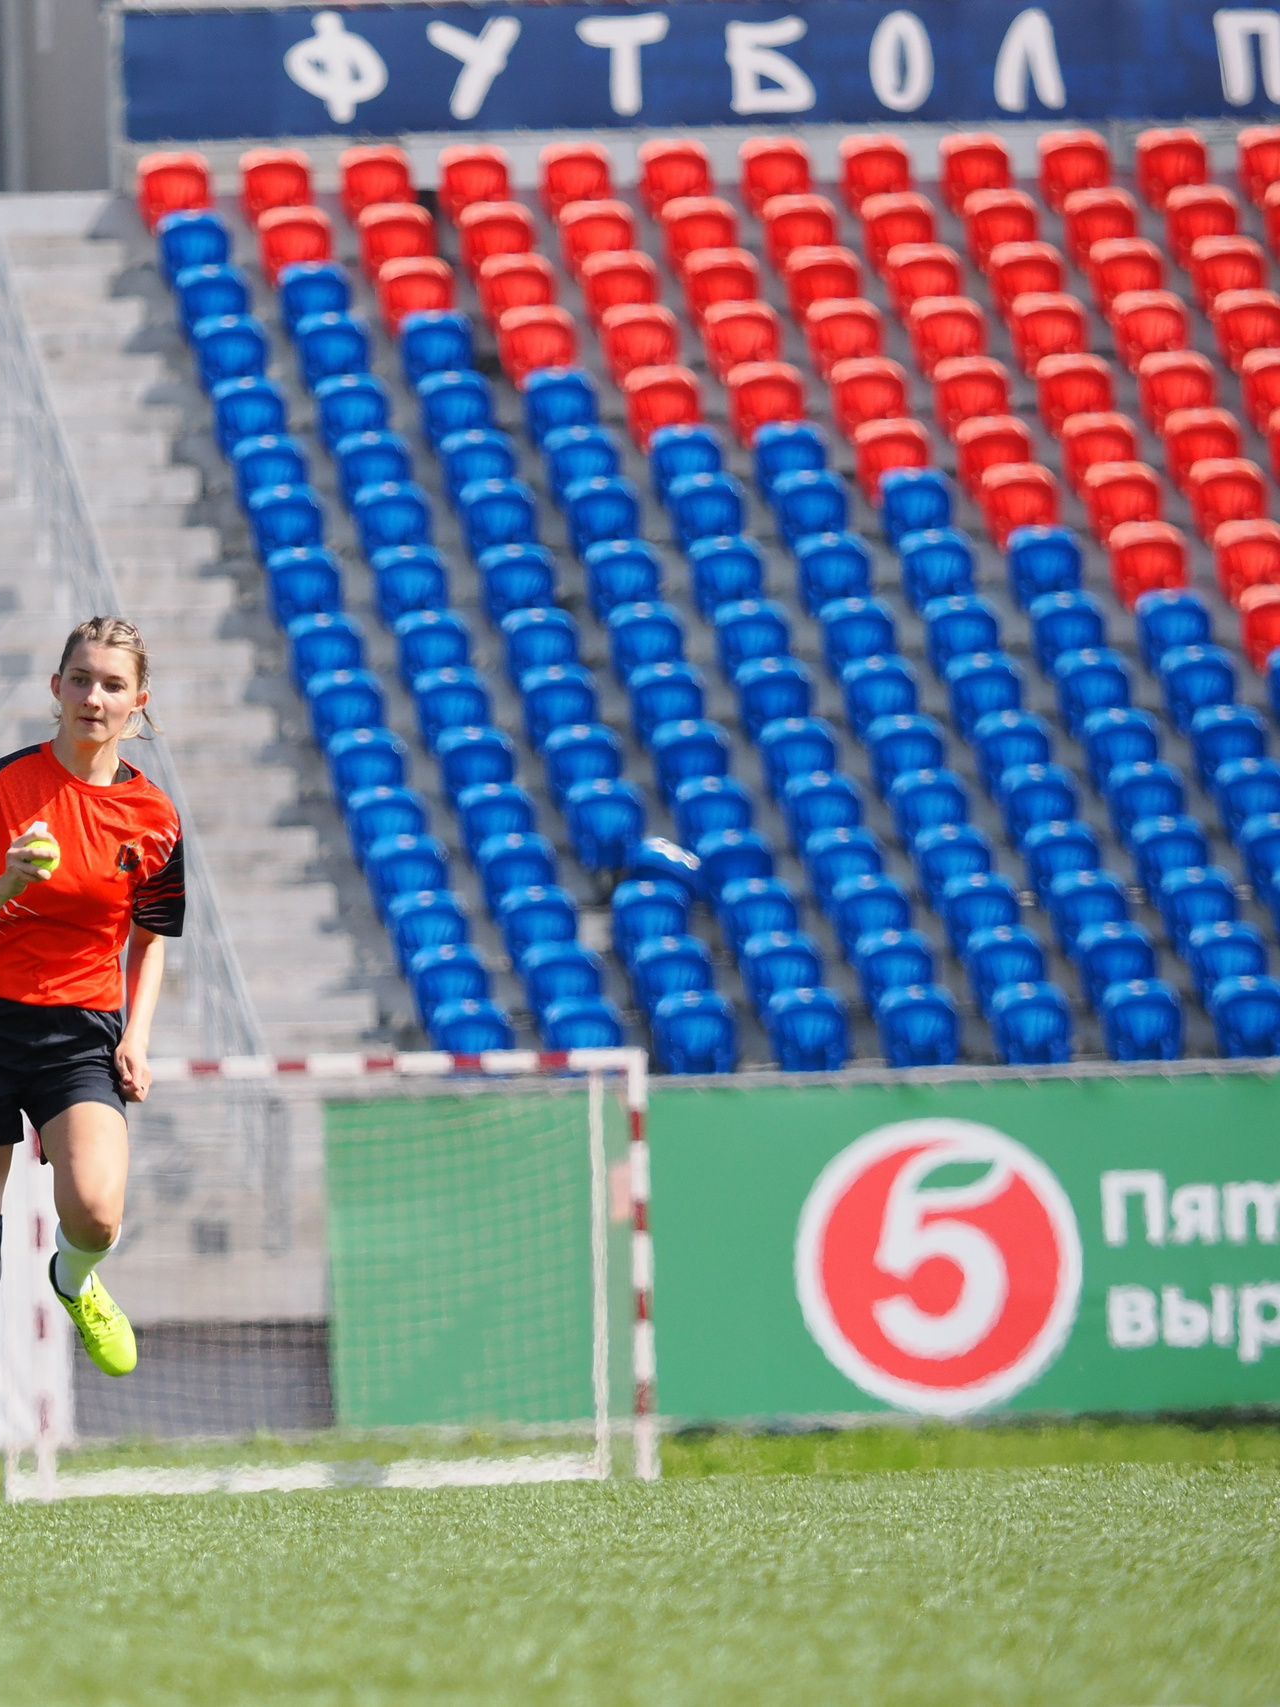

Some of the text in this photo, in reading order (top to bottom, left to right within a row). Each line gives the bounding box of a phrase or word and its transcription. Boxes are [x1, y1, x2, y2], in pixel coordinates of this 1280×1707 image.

[283, 10, 1067, 122] ФУТБОЛ
[873, 1152, 1011, 1361] 5
[1107, 1283, 1280, 1363] выр
